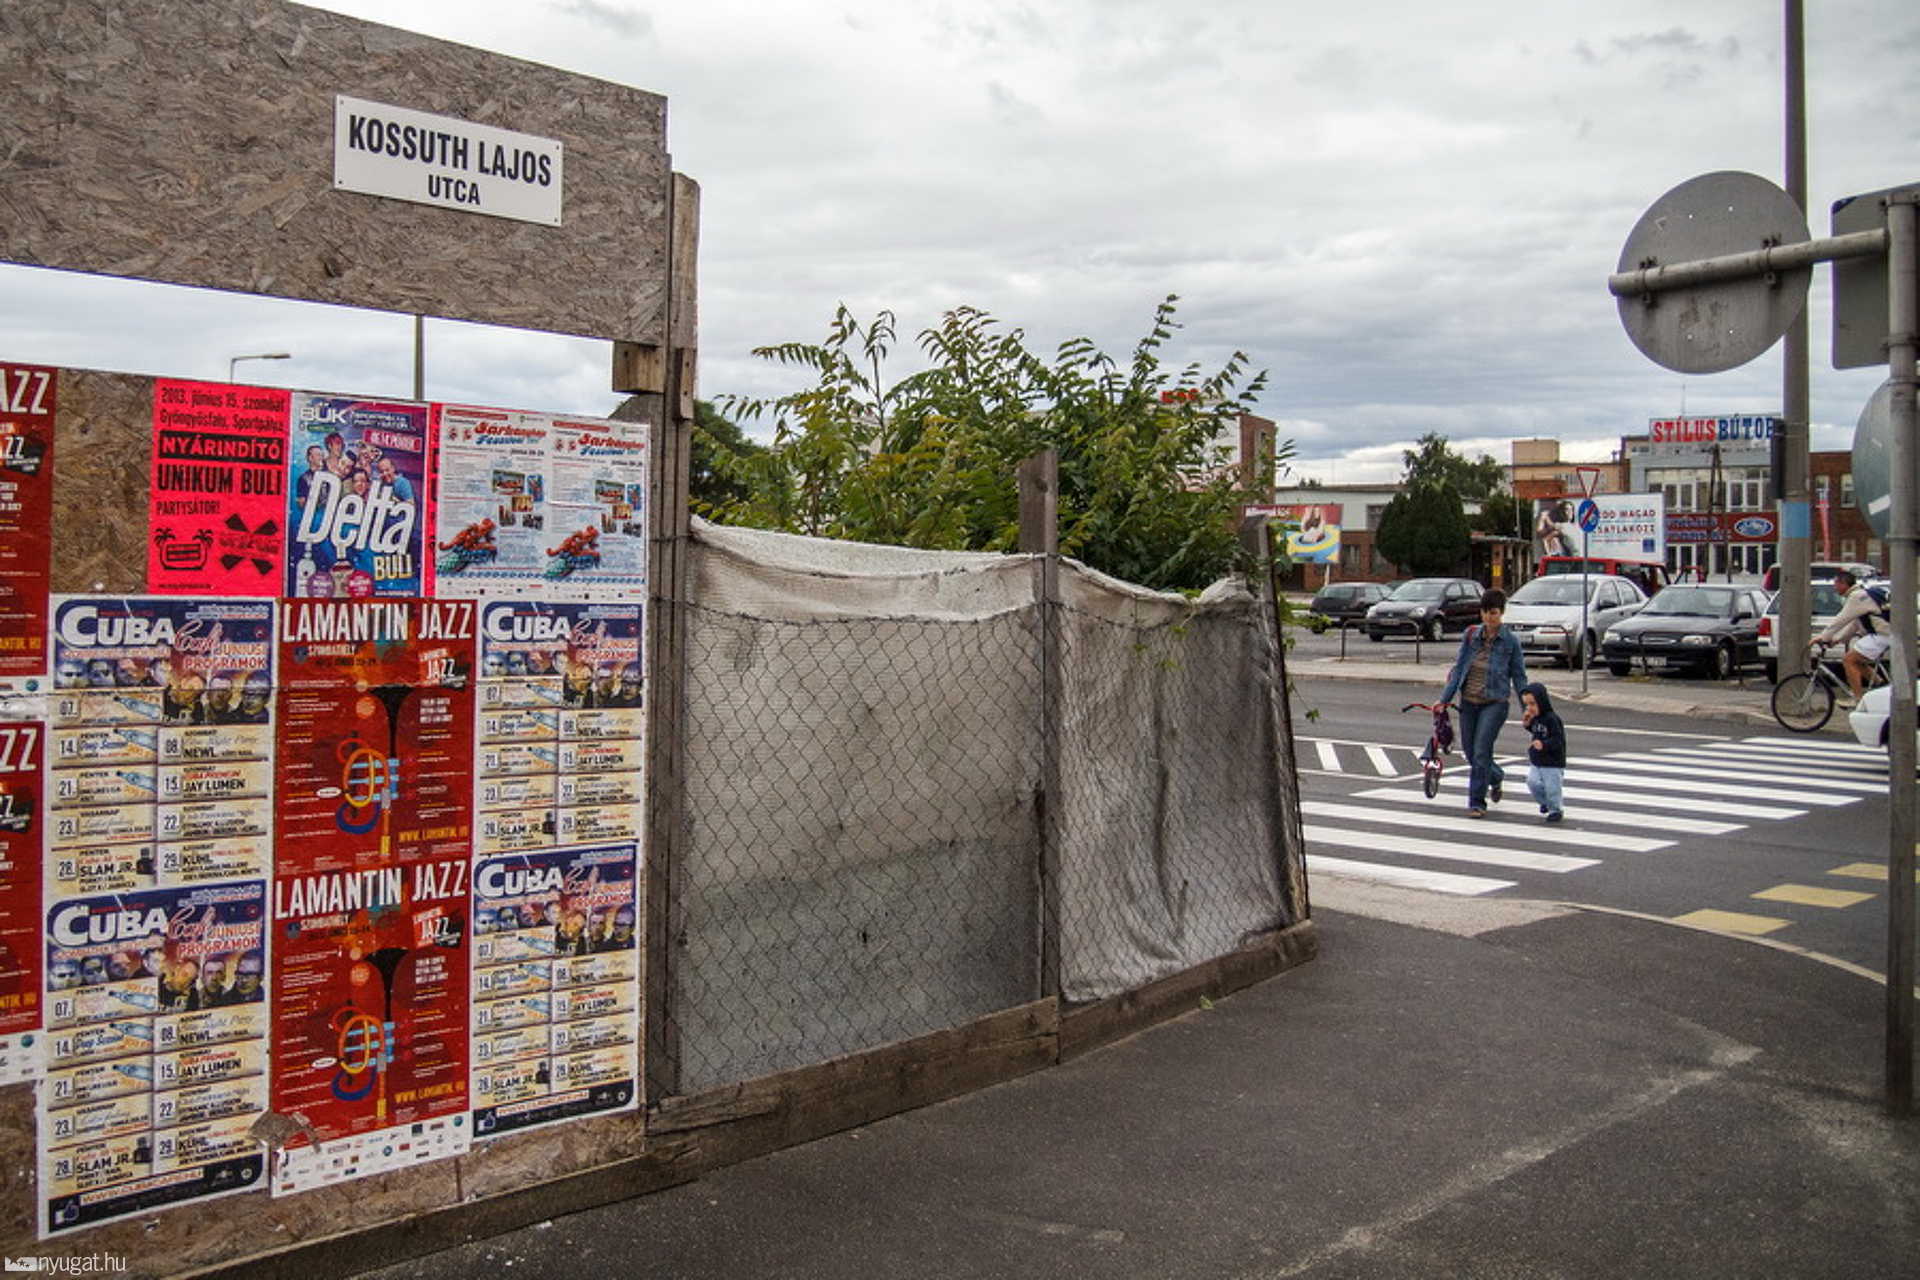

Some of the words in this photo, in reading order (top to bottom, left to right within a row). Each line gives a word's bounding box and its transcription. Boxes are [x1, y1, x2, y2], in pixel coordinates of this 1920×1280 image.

[349, 114, 468, 171] KOSSUTH
[478, 141, 551, 187] LAJOS
[428, 174, 481, 205] UTCA
[161, 434, 281, 461] NYÁRINDÍTÓ
[157, 464, 234, 493] UNIKUM
[240, 468, 283, 496] BULI
[296, 470, 415, 556] Delta
[373, 554, 412, 580] BULI
[61, 605, 175, 647] CUBA
[283, 603, 409, 643] LAMANTIN
[418, 603, 473, 641] JAZZ
[487, 606, 573, 642] CUBA
[206, 778, 246, 792] LUMEN
[80, 864, 114, 878] SLAM
[478, 863, 565, 898] CUBA
[275, 867, 402, 919] LAMANTIN
[412, 860, 466, 902] JAZZ
[53, 904, 168, 947] CUBA
[202, 1058, 242, 1074] LUMEN
[76, 1155, 112, 1174] SLAM
